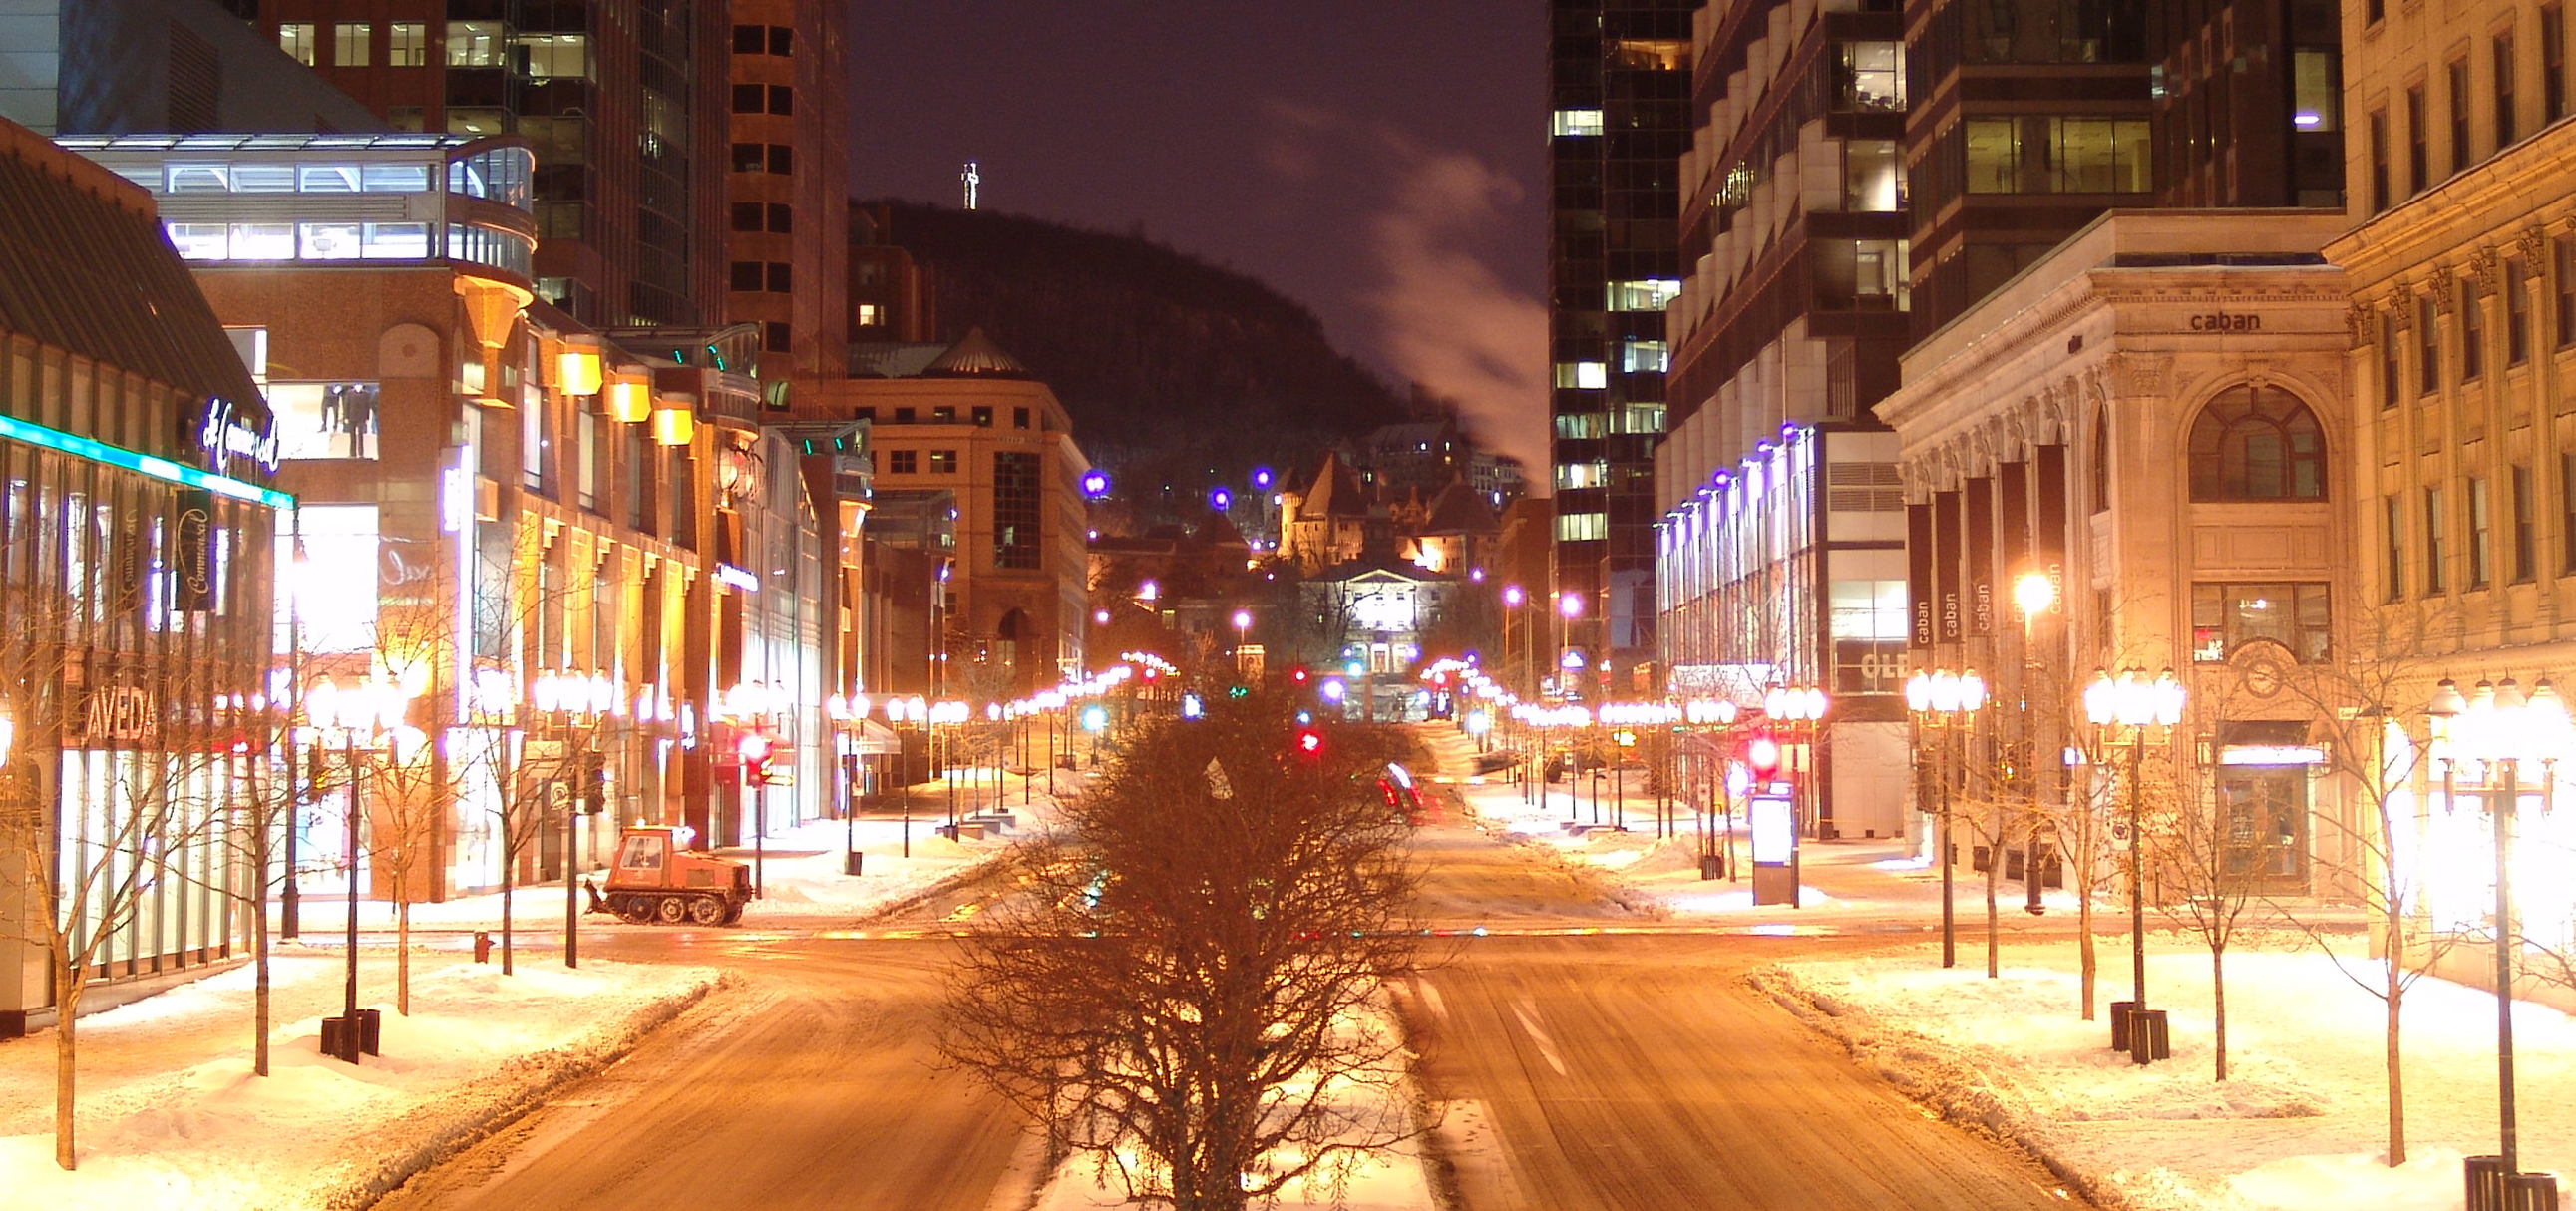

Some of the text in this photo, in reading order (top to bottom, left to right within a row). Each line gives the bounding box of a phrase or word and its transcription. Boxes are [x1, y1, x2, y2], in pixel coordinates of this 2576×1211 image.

[2190, 310, 2261, 330] caban
[178, 508, 208, 594] Commensal
[1917, 601, 1930, 644] caban
[1945, 593, 1957, 638] caban
[1976, 584, 1989, 631] caban
[86, 685, 157, 739] AVEDA
